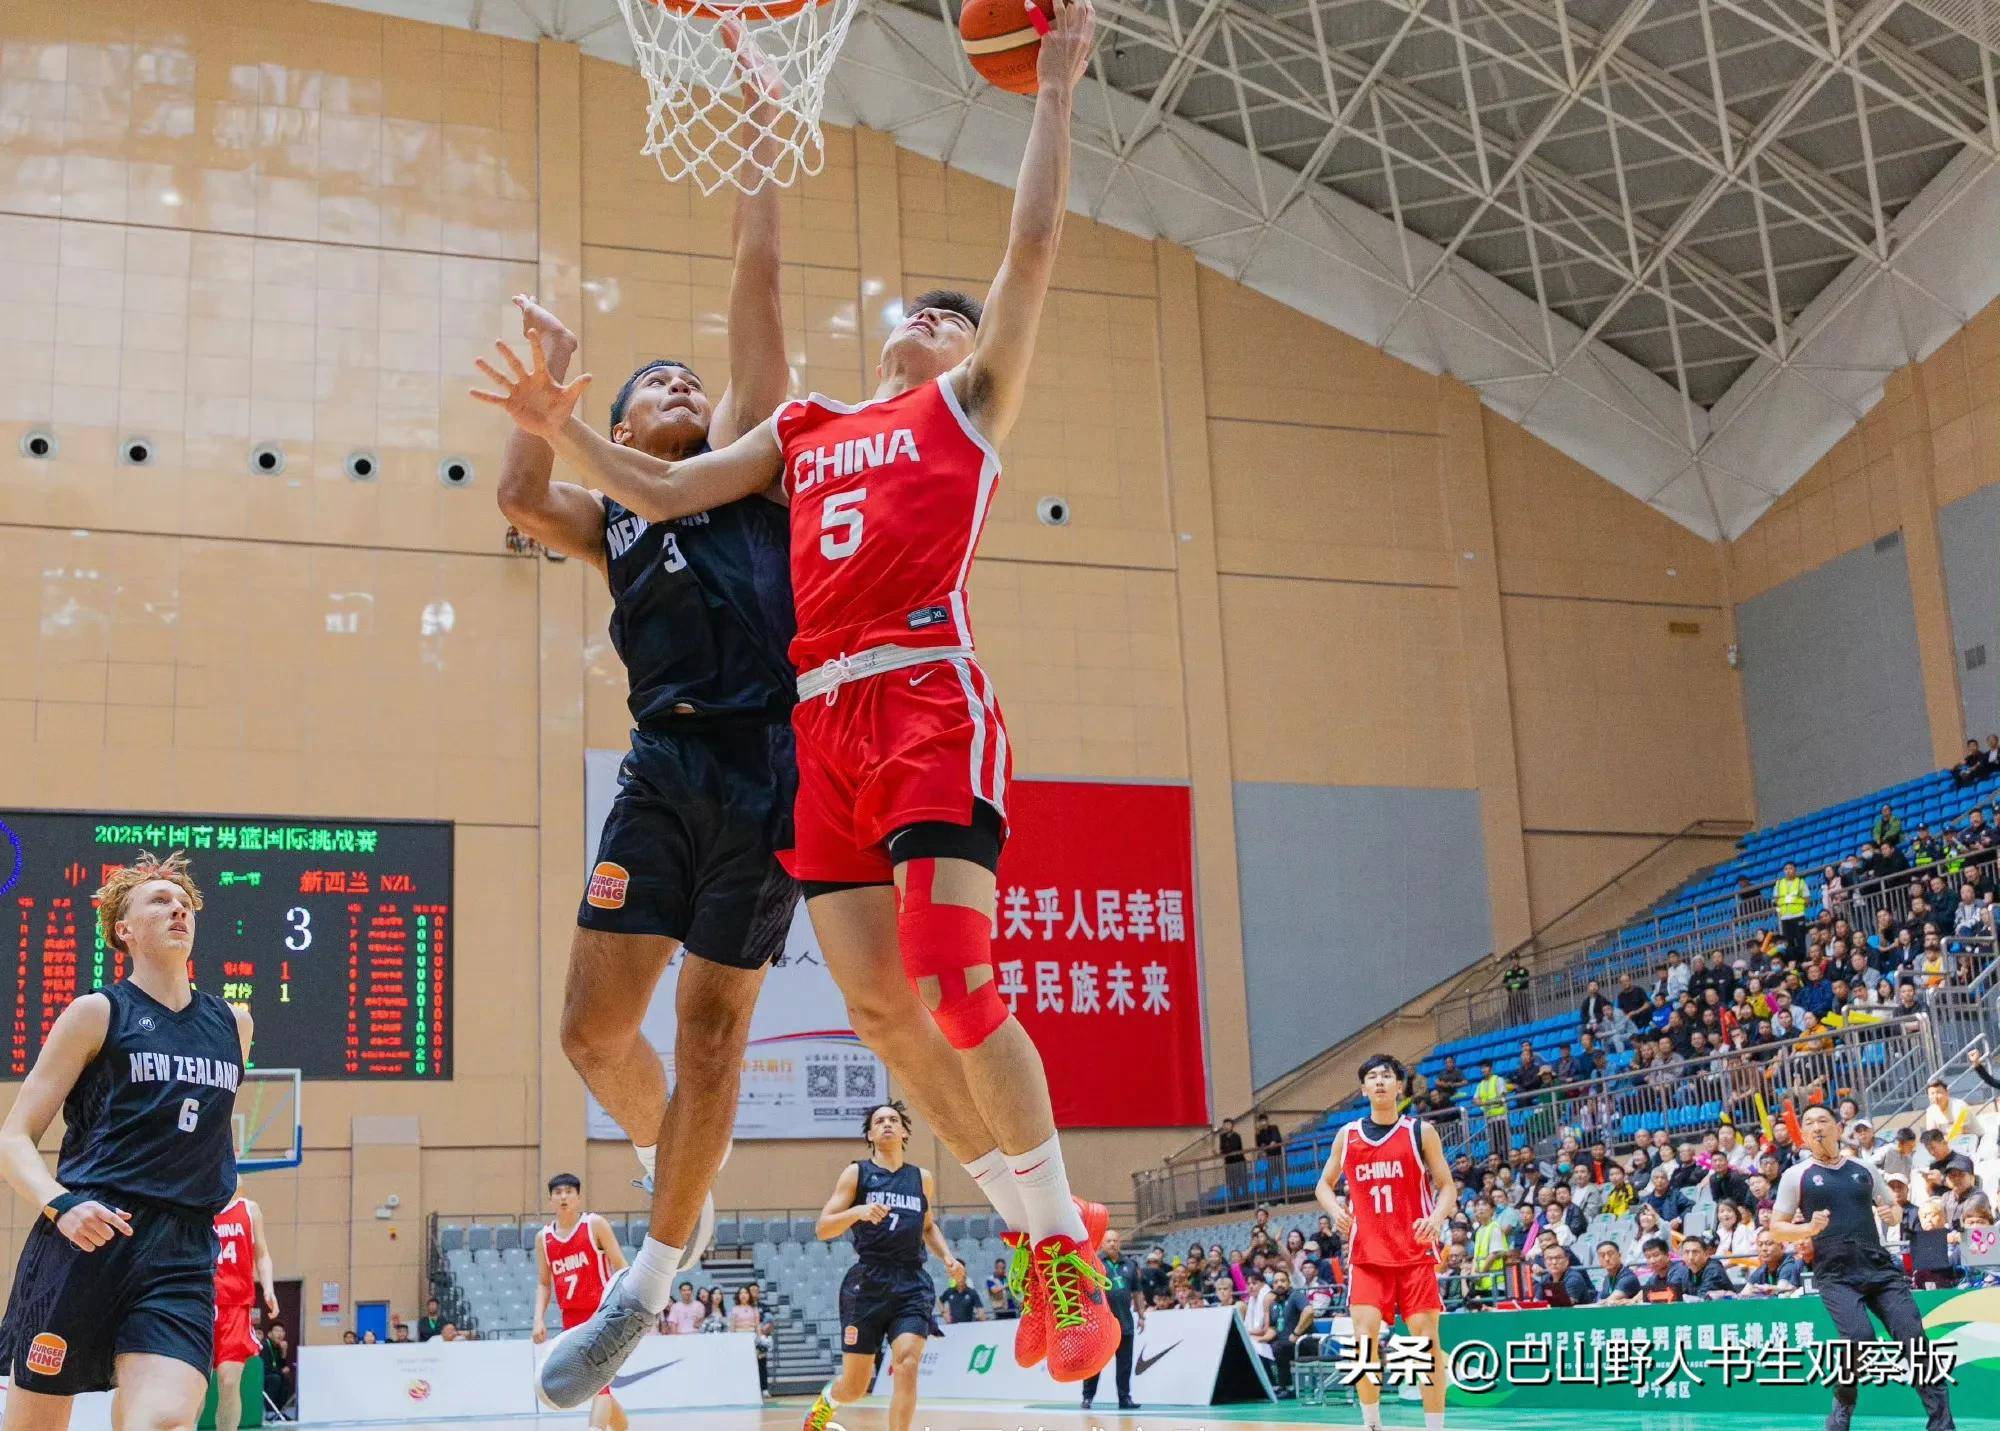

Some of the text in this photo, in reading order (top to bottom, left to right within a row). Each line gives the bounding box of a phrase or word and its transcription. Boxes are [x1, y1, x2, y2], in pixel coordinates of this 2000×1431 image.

[794, 428, 920, 494] CHINA
[820, 487, 867, 561] 5
[663, 532, 687, 574] 3
[932, 610, 945, 619] XL
[300, 870, 370, 893] 新西兰
[590, 884, 624, 900] KING
[592, 874, 625, 889] BURGER
[284, 906, 313, 951] 3
[280, 961, 291, 981] 1
[280, 983, 291, 1003] 1
[997, 959, 1171, 1015] 乎民族未来
[129, 1052, 239, 1094] NEW ZEALAND
[178, 1097, 200, 1133] 6
[1355, 1160, 1404, 1182] CHINA
[885, 1192, 921, 1213] ZEALAND
[1368, 1184, 1394, 1214] 11
[888, 1213, 900, 1231] 7
[552, 1250, 590, 1275] CHINA
[563, 1274, 578, 1300] 7
[30, 1351, 61, 1368] KING
[32, 1343, 64, 1357] BURGER
